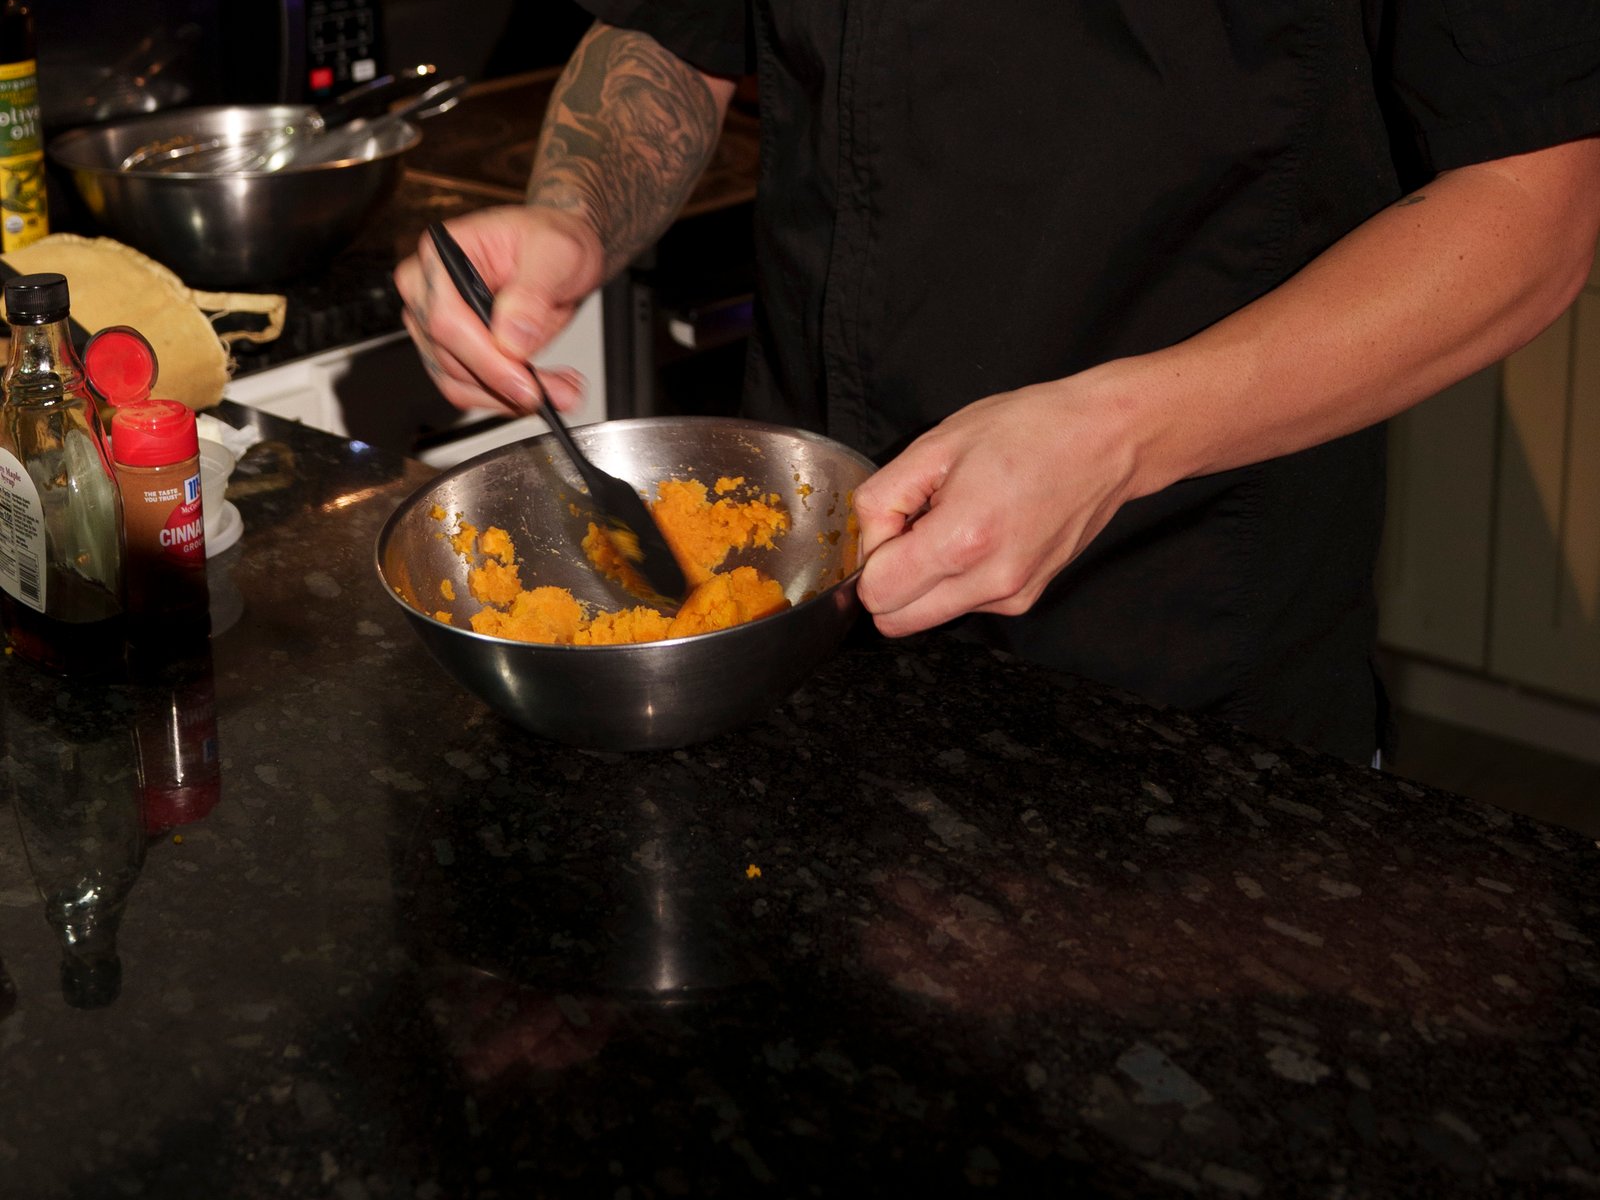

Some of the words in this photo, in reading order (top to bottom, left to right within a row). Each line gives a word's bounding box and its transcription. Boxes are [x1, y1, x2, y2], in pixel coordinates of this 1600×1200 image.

[10, 121, 35, 140] oil
[159, 488, 178, 497] TASTE
[160, 516, 203, 547] CINNA
